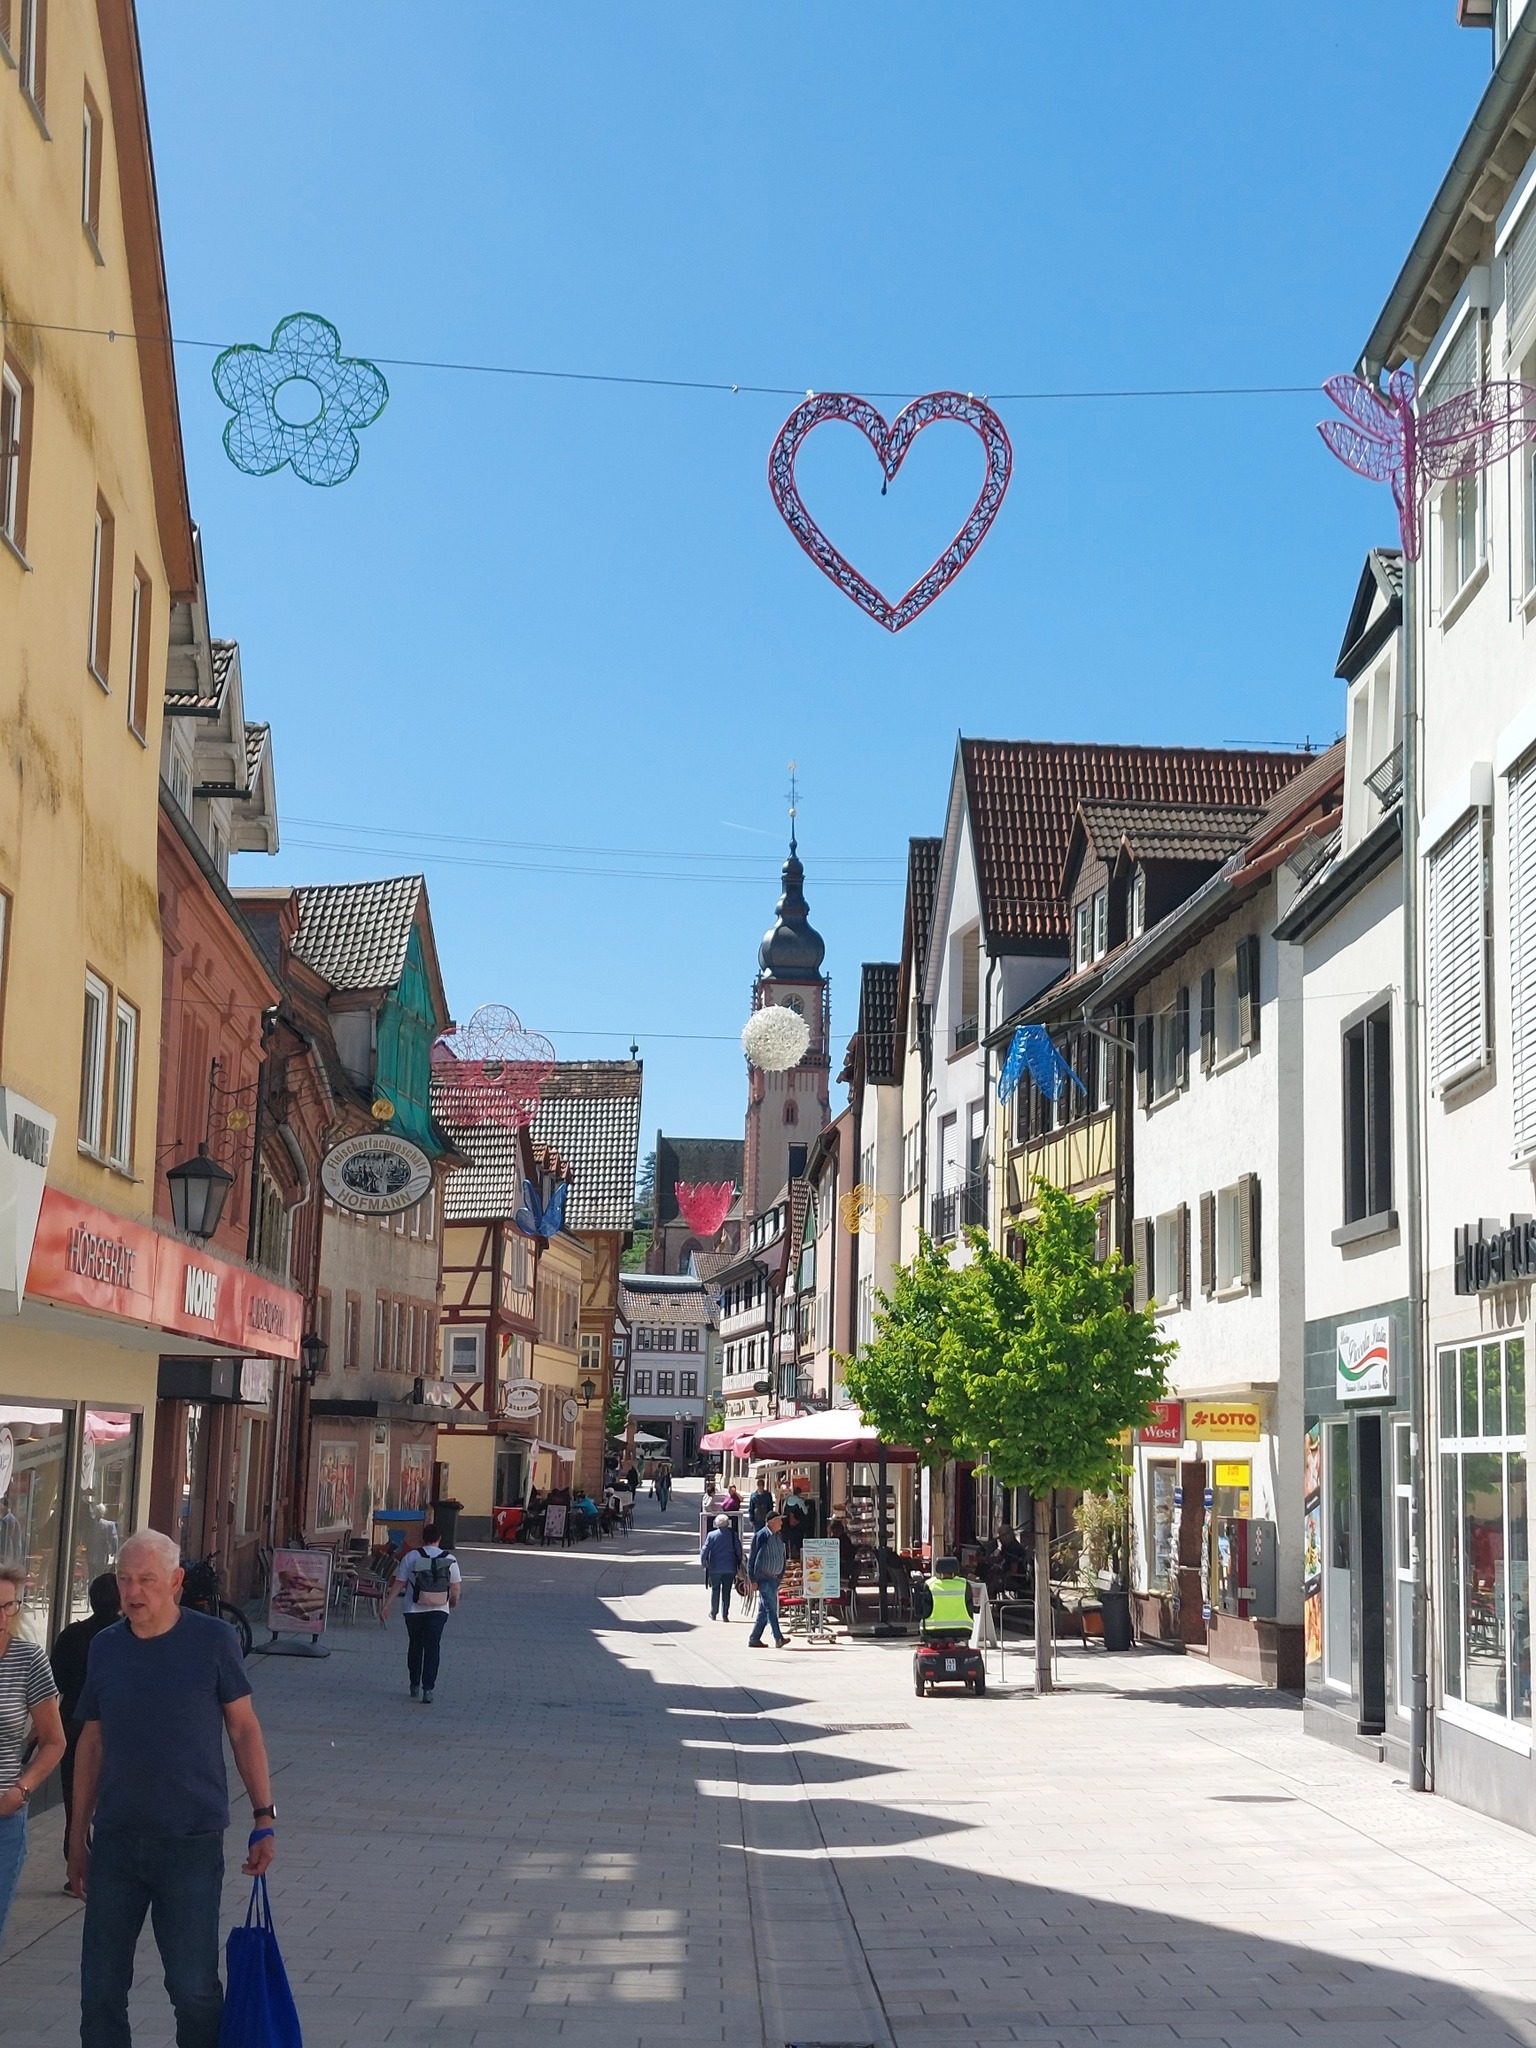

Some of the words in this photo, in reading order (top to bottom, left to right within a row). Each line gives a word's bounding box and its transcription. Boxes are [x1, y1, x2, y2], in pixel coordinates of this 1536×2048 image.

[327, 1138, 428, 1173] Fleischerfachgeschäft
[337, 1188, 412, 1210] HOFMANN
[65, 1221, 137, 1290] HÖRGERÄTE
[184, 1264, 217, 1321] NOHE
[1210, 1413, 1256, 1425] LOTTO
[1144, 1426, 1177, 1438] West
